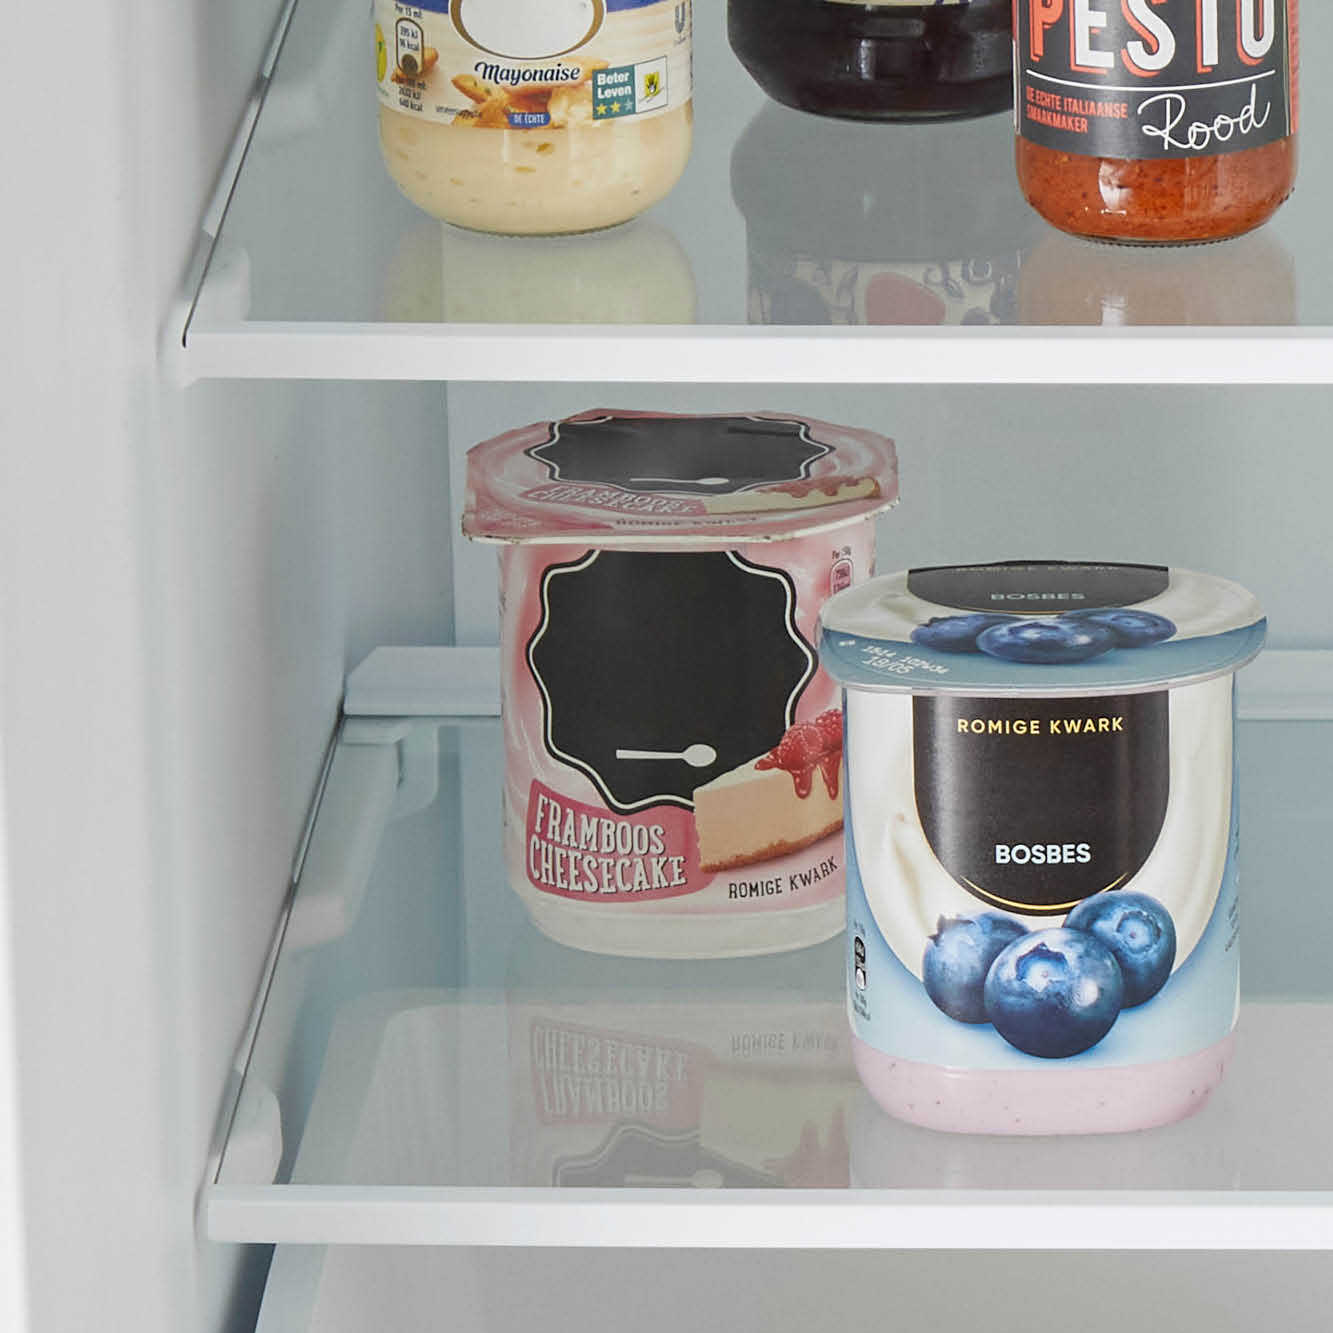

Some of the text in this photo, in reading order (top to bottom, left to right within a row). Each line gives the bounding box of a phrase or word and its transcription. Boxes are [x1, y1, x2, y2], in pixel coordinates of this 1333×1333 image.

[1030, 0, 1275, 77] PESTO
[474, 61, 581, 86] Mayonaise
[597, 70, 631, 87] Beter
[597, 84, 633, 99] Leven
[1036, 89, 1128, 120] ECHTE ITALIAANSE
[1026, 107, 1088, 134] SMAAKMAKER
[1137, 83, 1271, 150] Rood
[990, 592, 1086, 601] BOSBES
[957, 715, 1125, 736] ROMIGE KWARK
[534, 792, 666, 857] FRAMBOOS
[528, 833, 687, 896] CHEESECAKE
[994, 843, 1092, 866] BOSBES
[728, 855, 839, 900] ROMIGE KWARK
